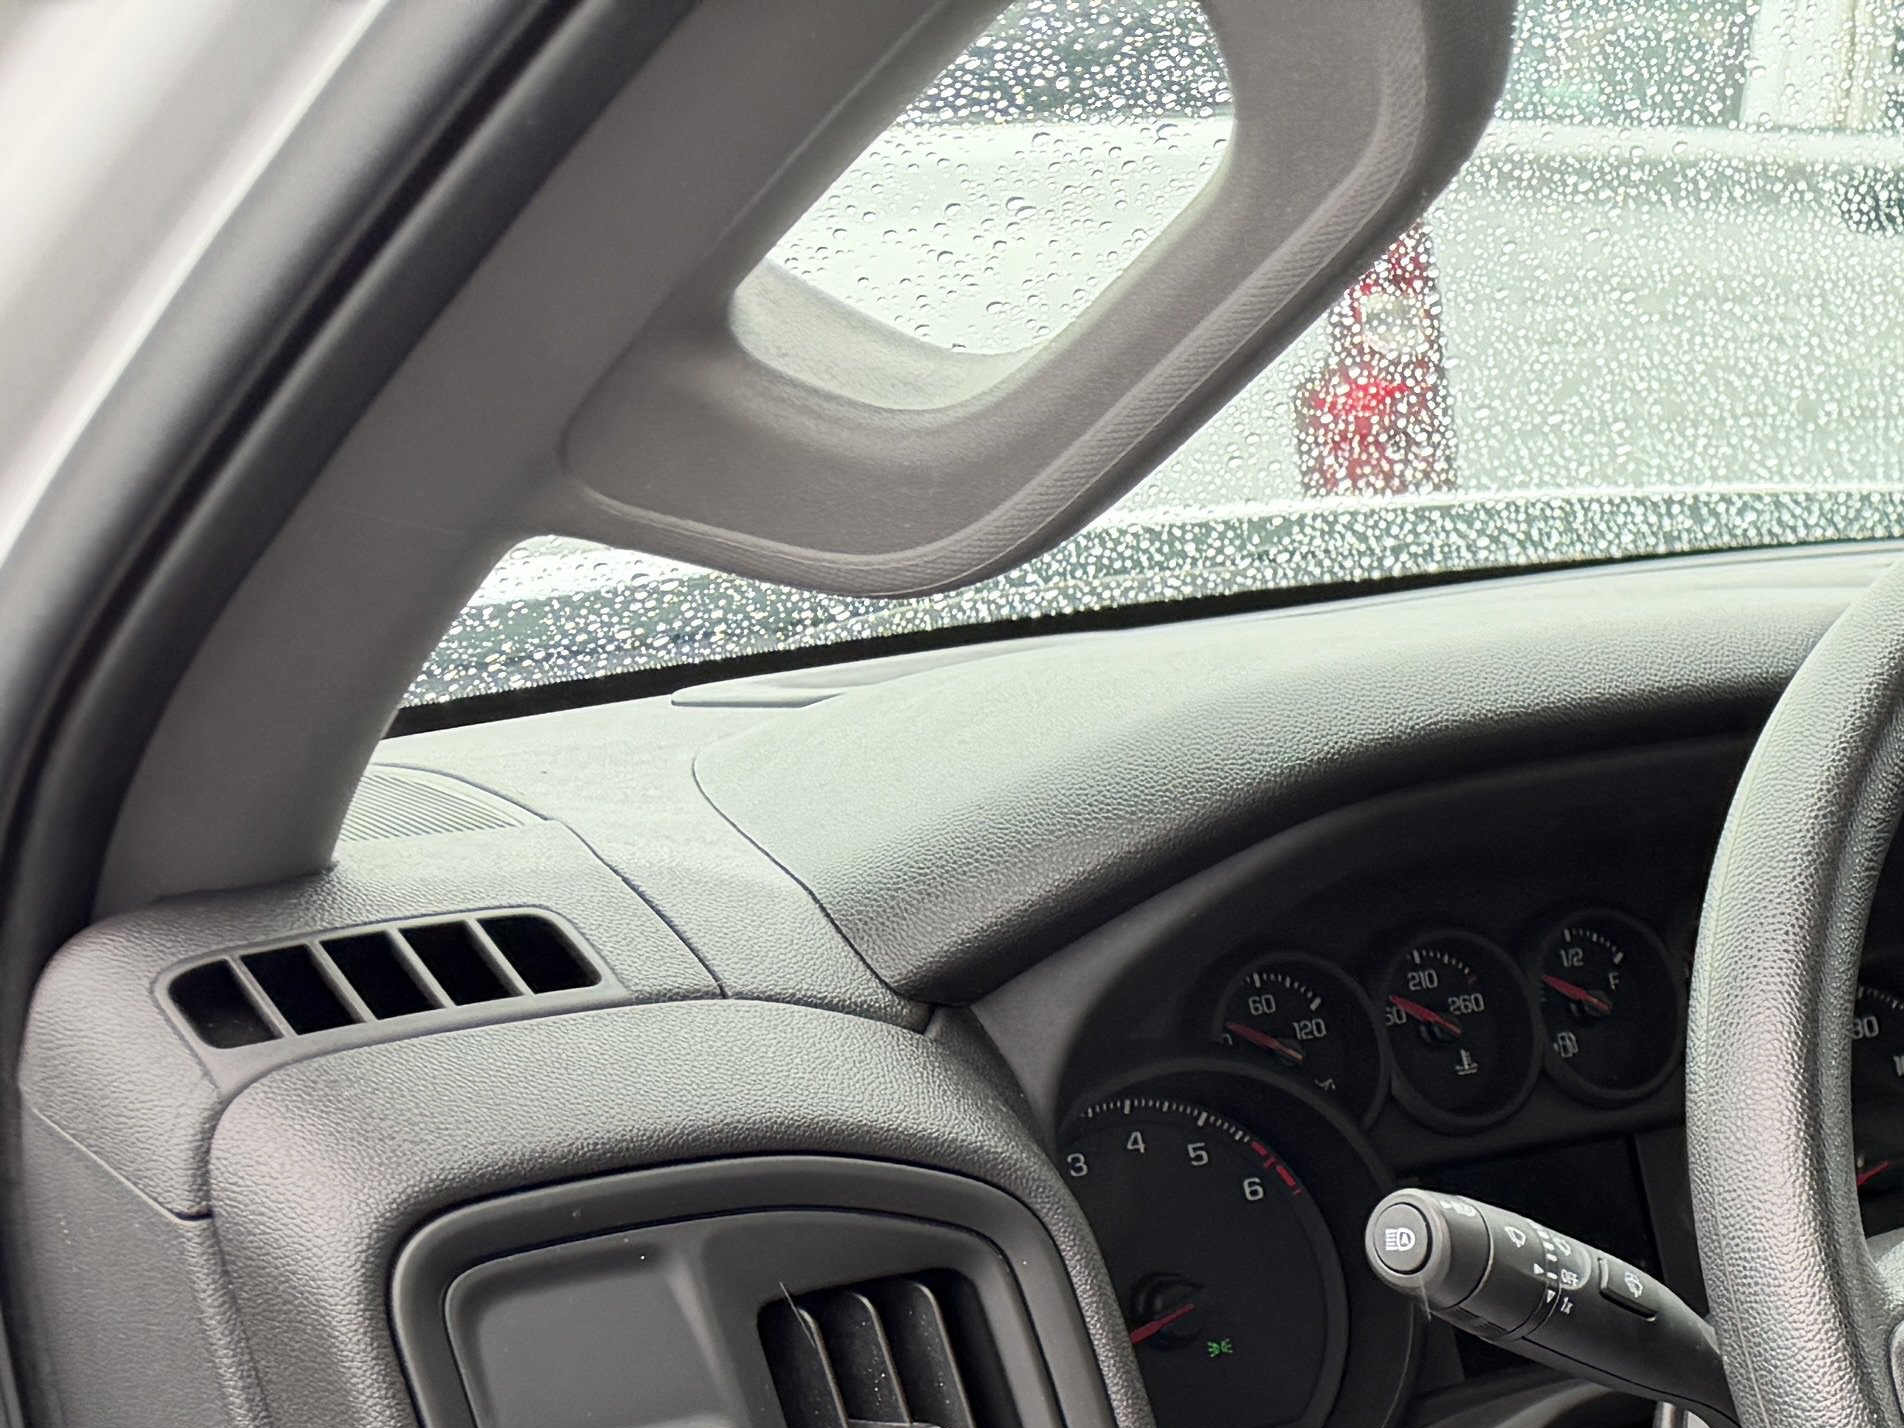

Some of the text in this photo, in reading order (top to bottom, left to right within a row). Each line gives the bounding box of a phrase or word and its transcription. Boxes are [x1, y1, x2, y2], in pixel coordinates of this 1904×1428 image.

[1407, 969, 1439, 991] 210
[1608, 972, 1620, 992] F
[1248, 994, 1276, 1016] 60
[1448, 993, 1485, 1015] 260
[1293, 1019, 1327, 1040] 120
[1126, 1131, 1146, 1154] 4
[1066, 1152, 1089, 1177] 3
[1187, 1142, 1209, 1166] 5
[1242, 1177, 1265, 1201] 6
[1560, 1268, 1579, 1287] OFF
